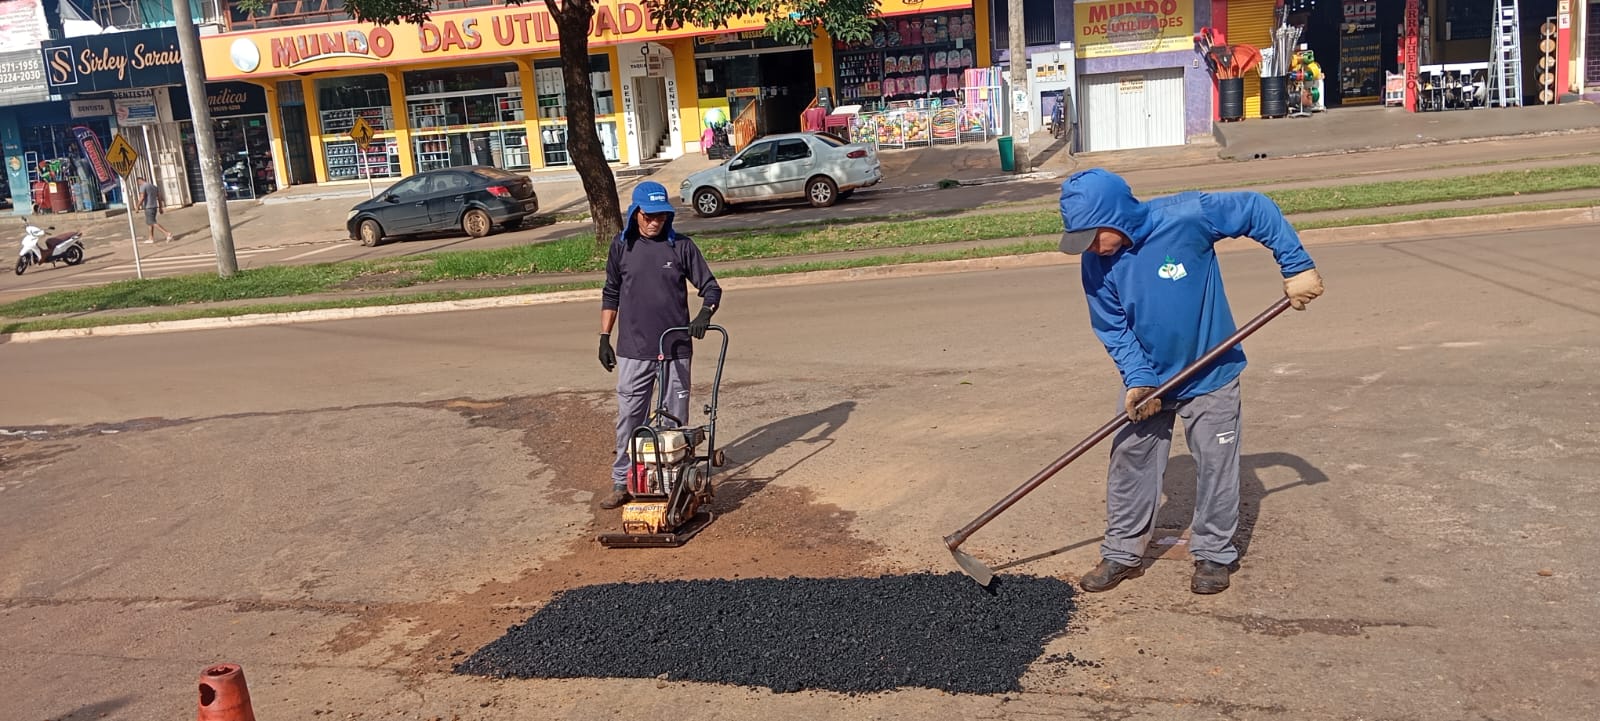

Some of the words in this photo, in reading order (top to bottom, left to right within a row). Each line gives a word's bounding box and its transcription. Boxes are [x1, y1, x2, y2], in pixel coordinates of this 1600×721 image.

[1083, 24, 1107, 36] DAS
[1111, 16, 1184, 33] UTILIDADES
[1088, 0, 1177, 24] MUNDO
[270, 26, 395, 68] MUNDO
[418, 18, 482, 52] DAS
[78, 48, 128, 81] Sirley
[78, 104, 105, 113] DENTISTA
[624, 84, 634, 136] DENTISTA
[668, 80, 679, 132] DENTISTA
